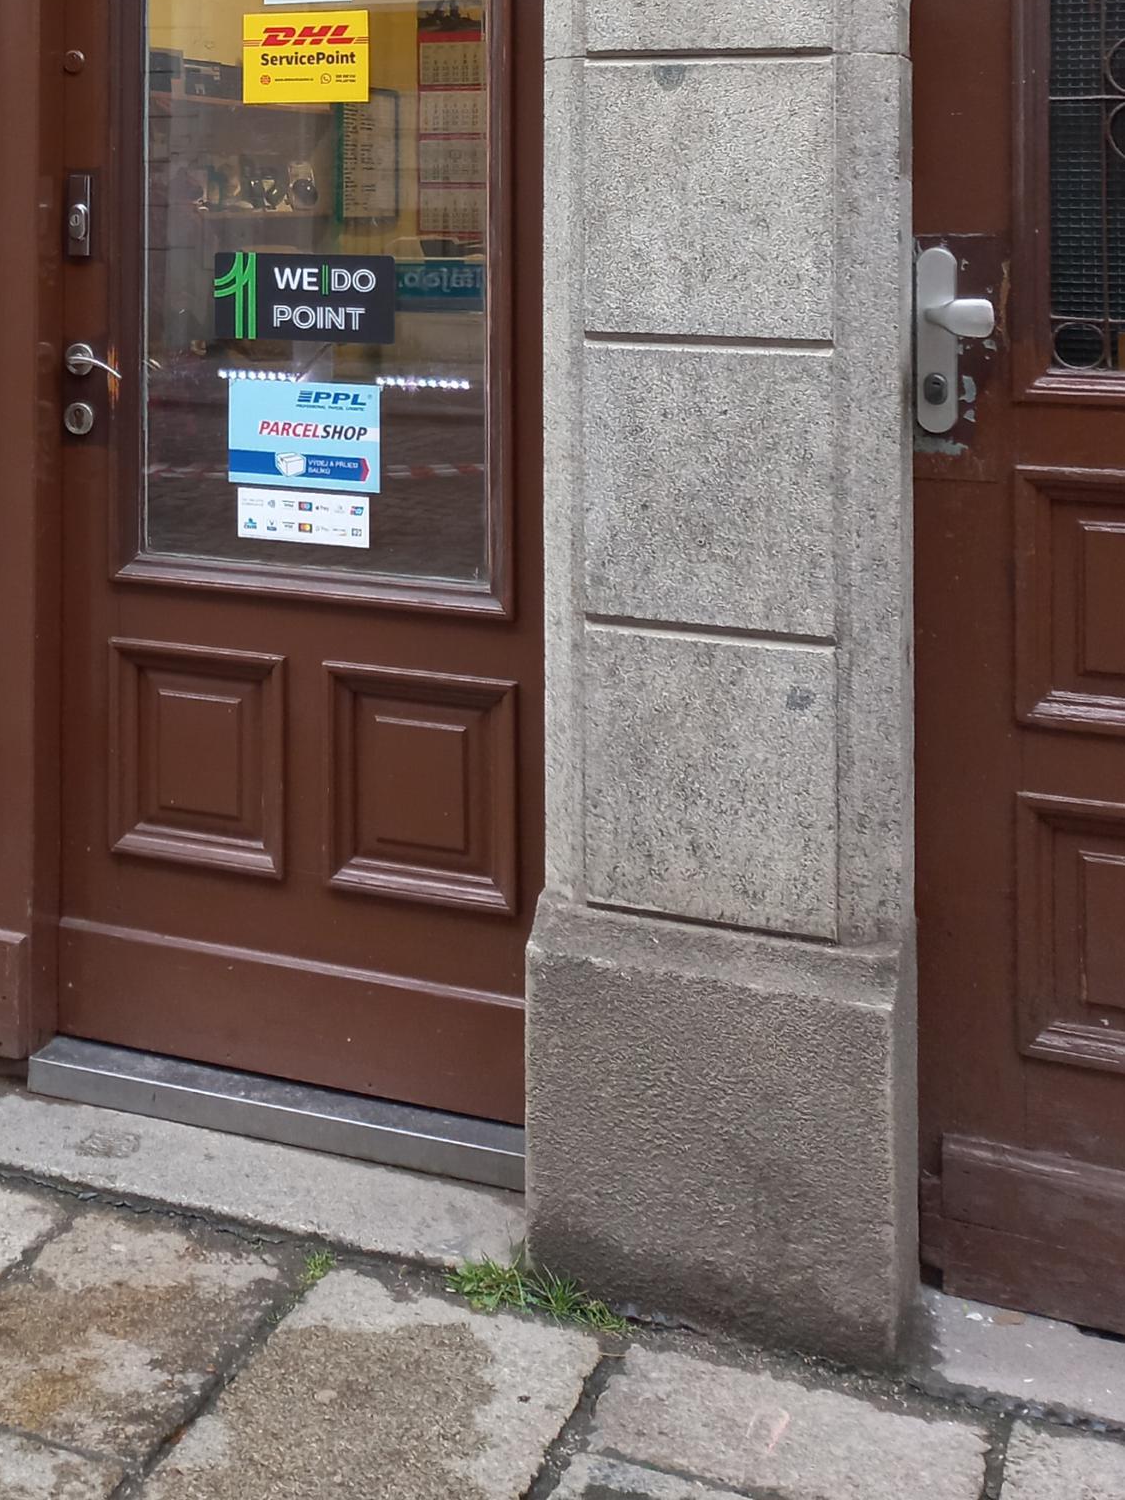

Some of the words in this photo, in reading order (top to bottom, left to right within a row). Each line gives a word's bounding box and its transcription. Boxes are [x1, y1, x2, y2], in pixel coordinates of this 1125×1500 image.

[261, 25, 350, 47] DHL
[260, 51, 355, 65] ServicePoint
[273, 305, 366, 331] POINT
[313, 391, 366, 406] PPL
[259, 421, 367, 441] PARCELSHOP
